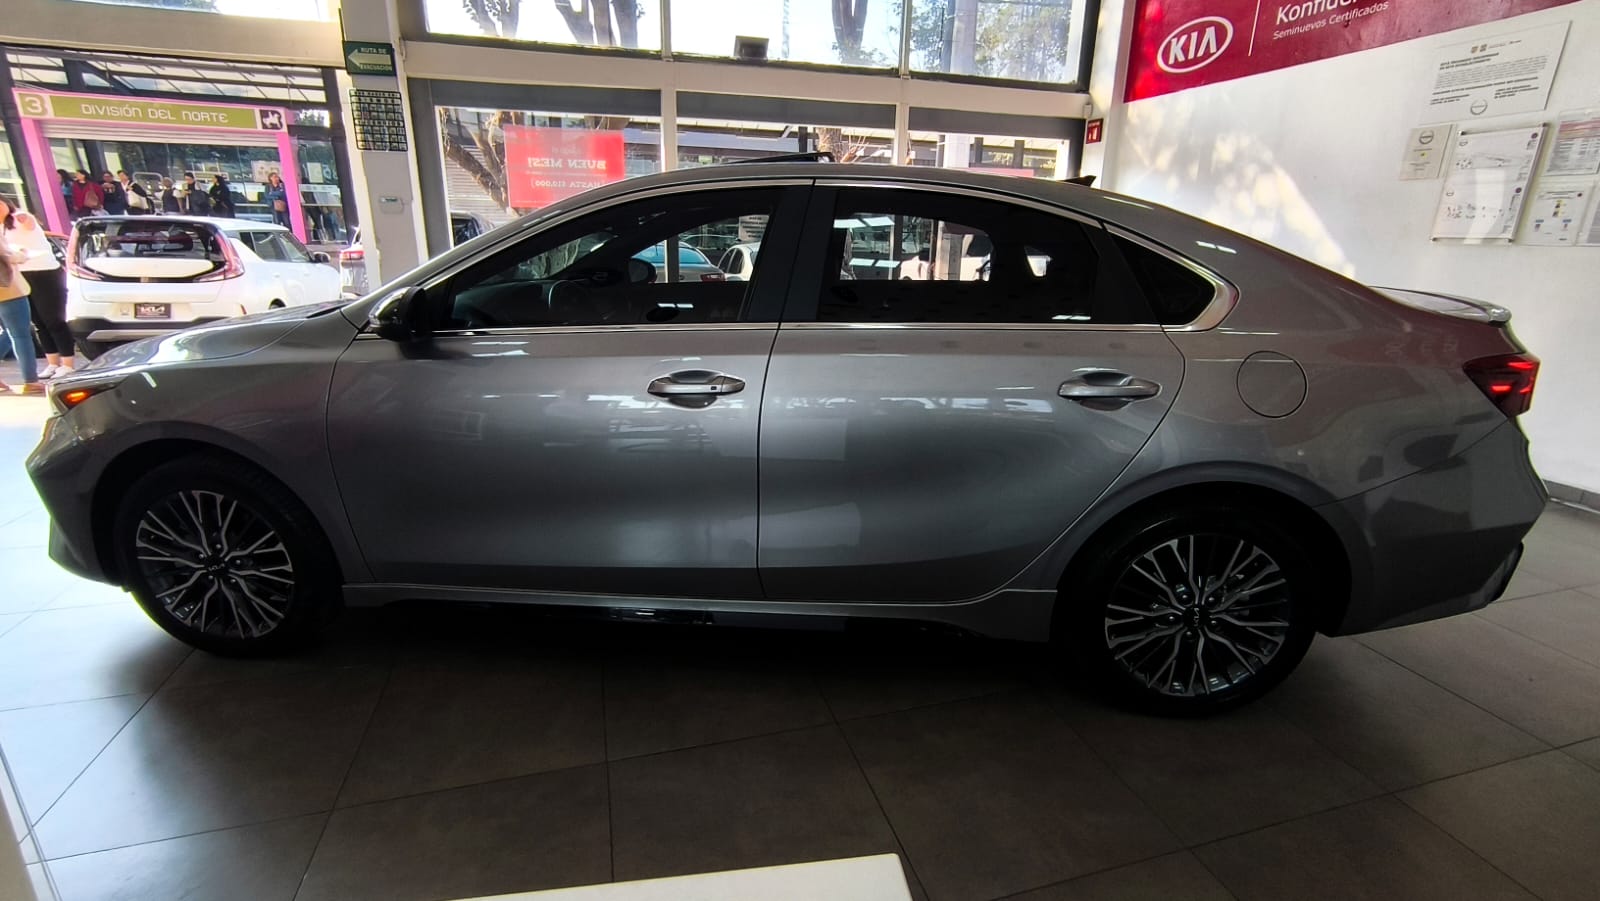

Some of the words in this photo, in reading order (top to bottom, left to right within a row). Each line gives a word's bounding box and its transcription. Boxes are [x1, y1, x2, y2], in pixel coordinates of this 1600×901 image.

[1272, 19, 1327, 40] Seminuevos
[1329, 1, 1390, 25] Certificados
[1168, 25, 1218, 65] KIA
[26, 97, 43, 114] 3
[80, 102, 143, 119] DIVISIÓN
[148, 108, 176, 121] DEL
[181, 111, 229, 124] NORTE
